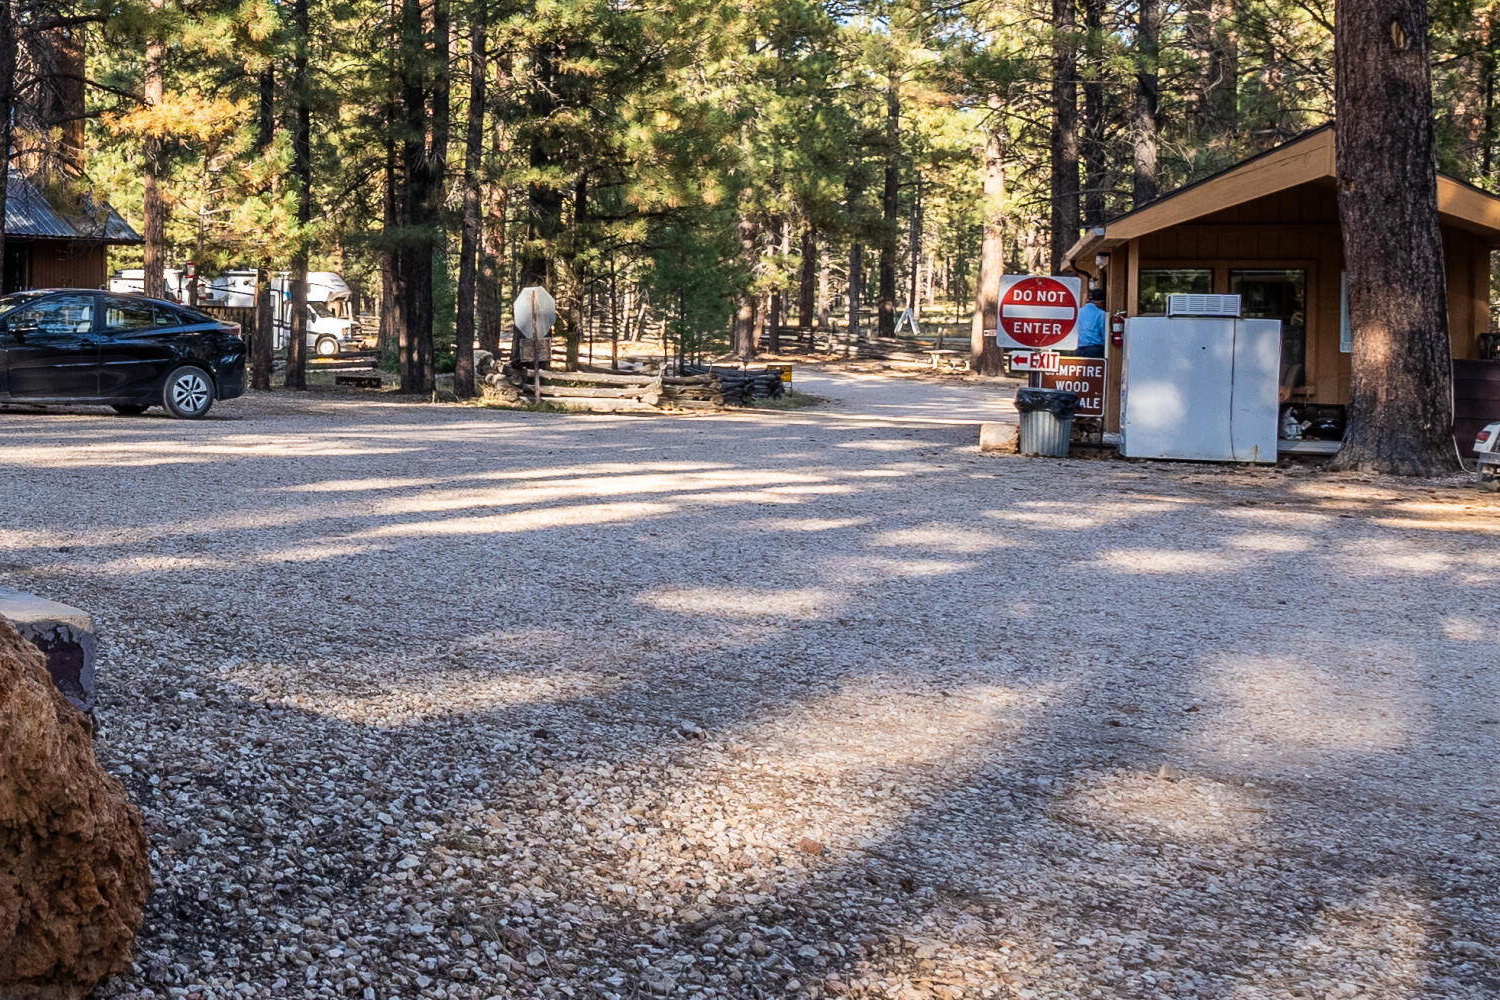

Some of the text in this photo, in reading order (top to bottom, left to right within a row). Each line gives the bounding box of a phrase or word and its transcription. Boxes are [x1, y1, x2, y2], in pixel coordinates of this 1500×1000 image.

[1013, 290, 1067, 303] DO NOT
[1013, 322, 1062, 335] ENTER
[1030, 352, 1058, 369] EXIT
[1055, 380, 1090, 393] WOOD
